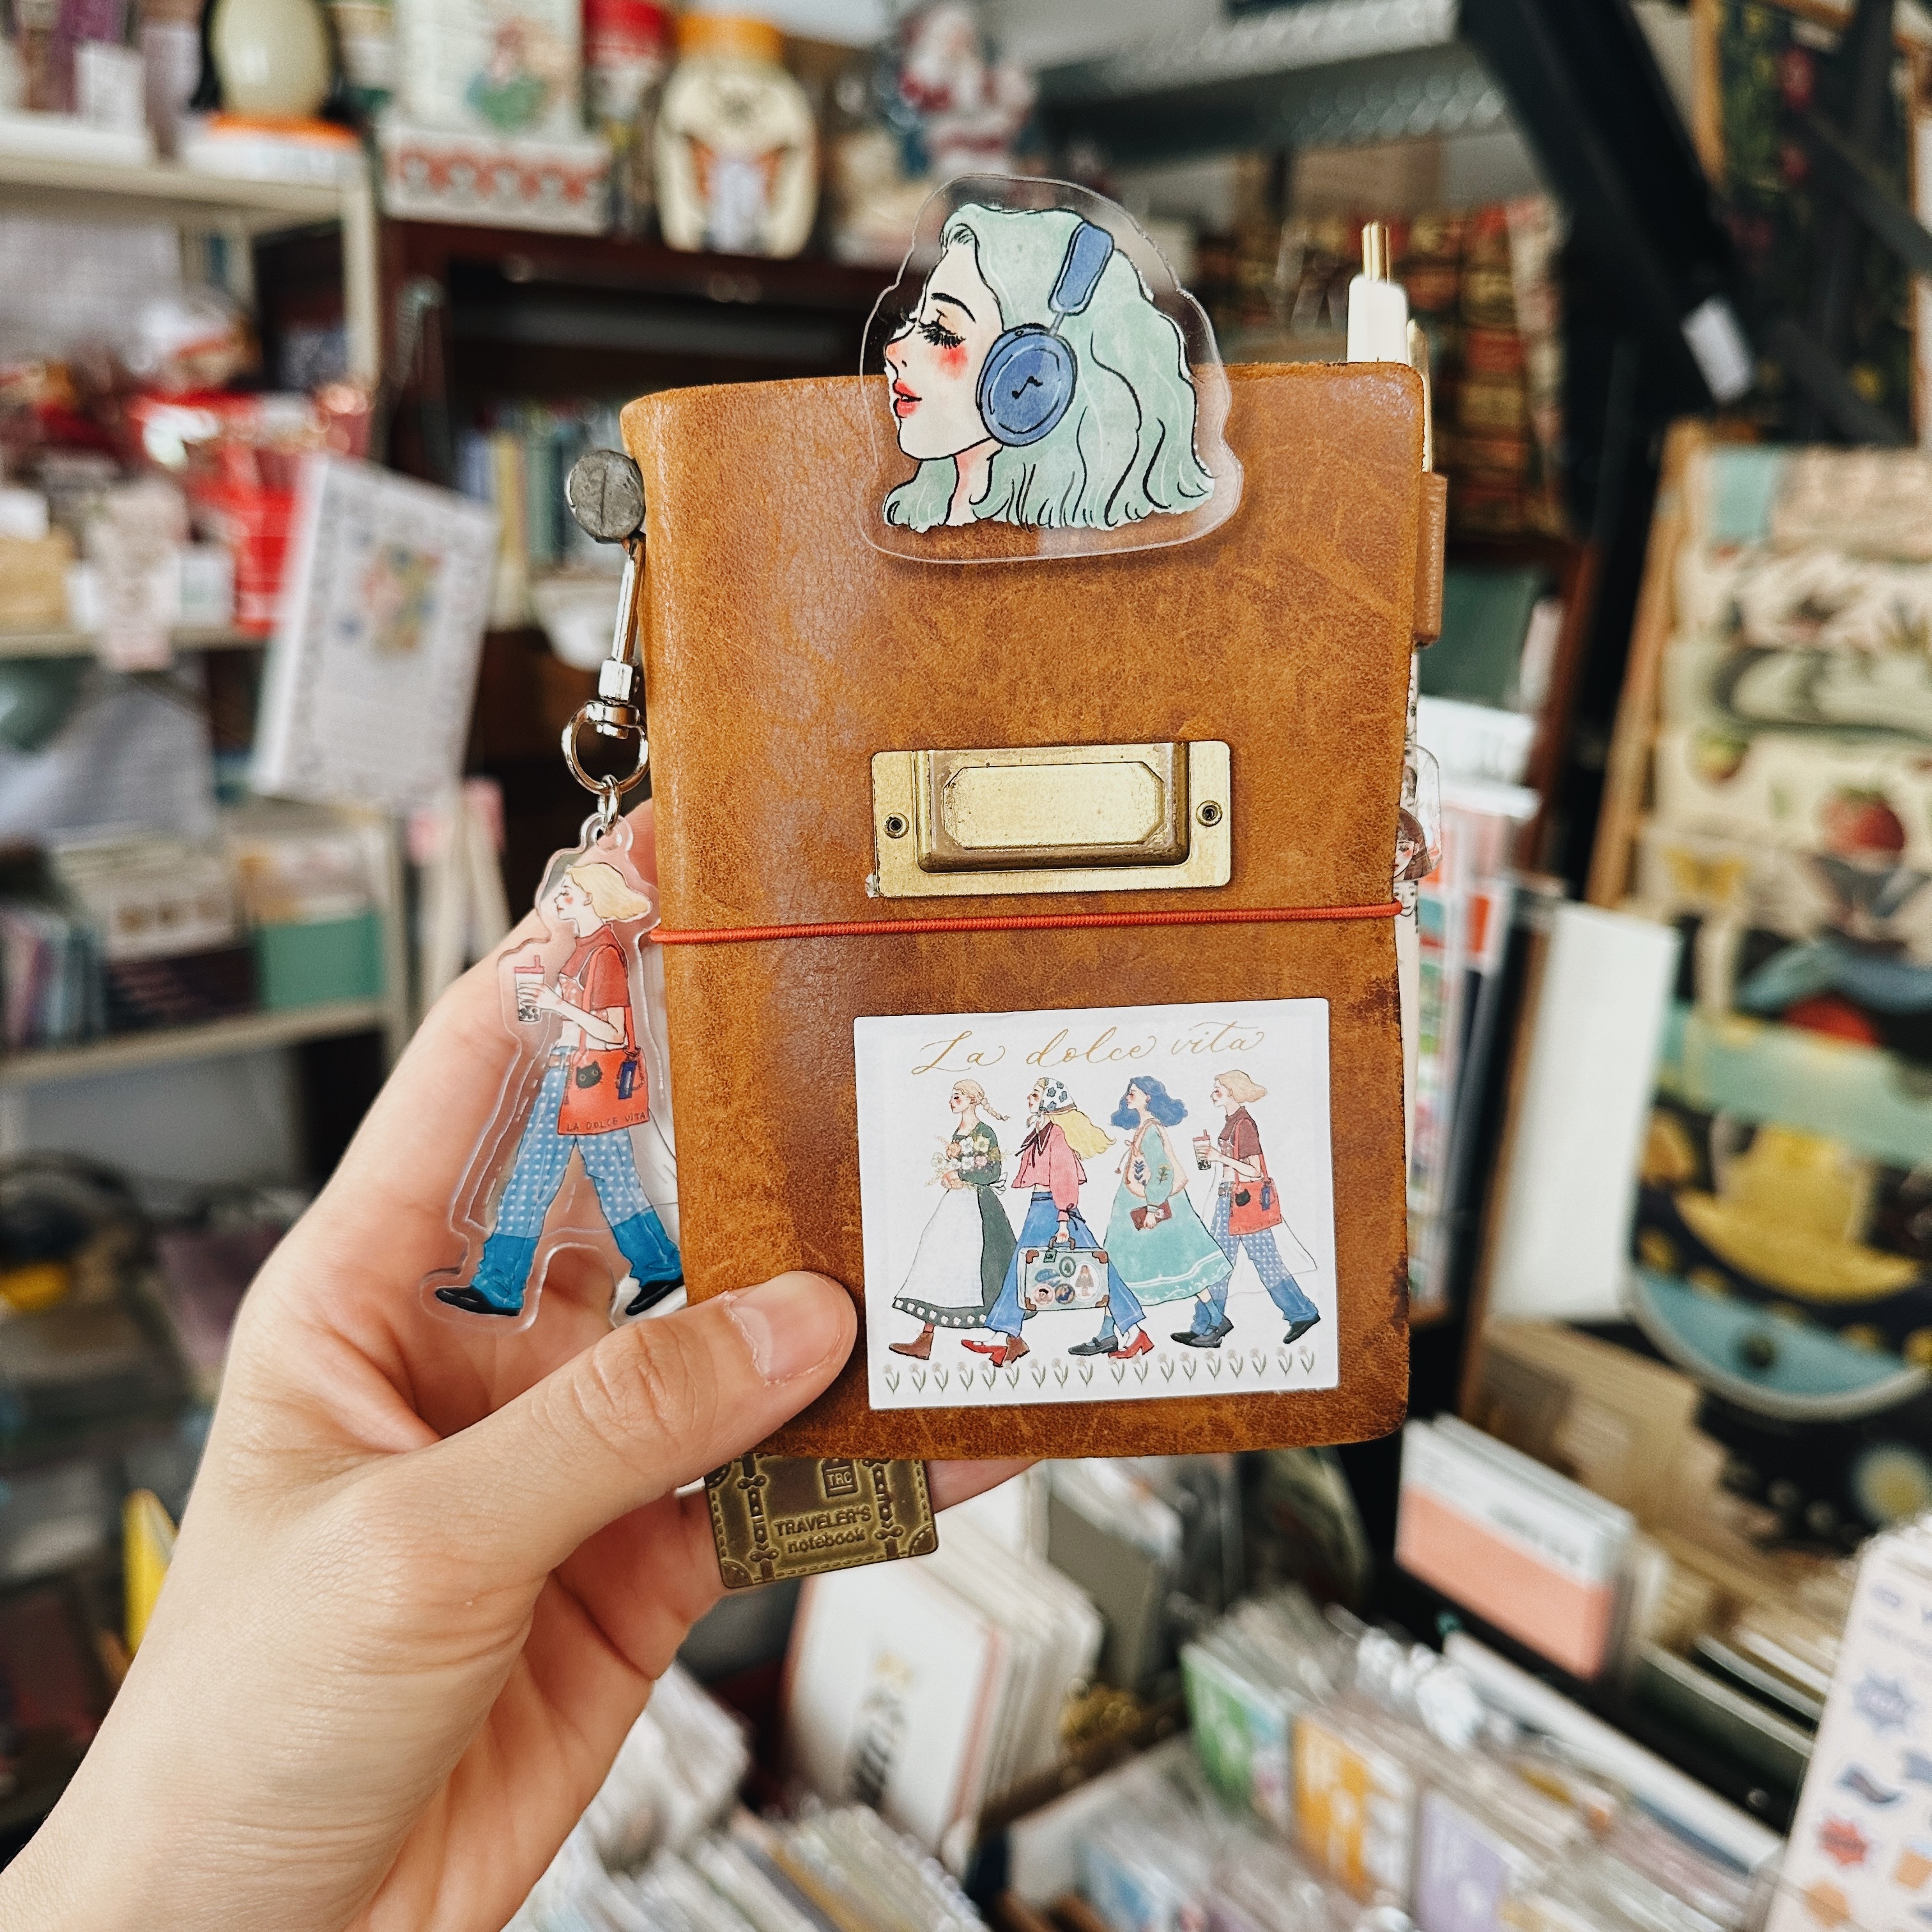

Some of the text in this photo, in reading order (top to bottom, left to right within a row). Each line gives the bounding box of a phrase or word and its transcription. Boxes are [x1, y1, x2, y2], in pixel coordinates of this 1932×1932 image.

[912, 1021, 1264, 1075] La dolce vita
[566, 1123, 579, 1131] LA
[586, 1117, 618, 1130] DOLCE
[827, 1471, 852, 1486] TRC
[774, 1505, 872, 1537] TRAVELER'S
[787, 1527, 866, 1553] notebook
